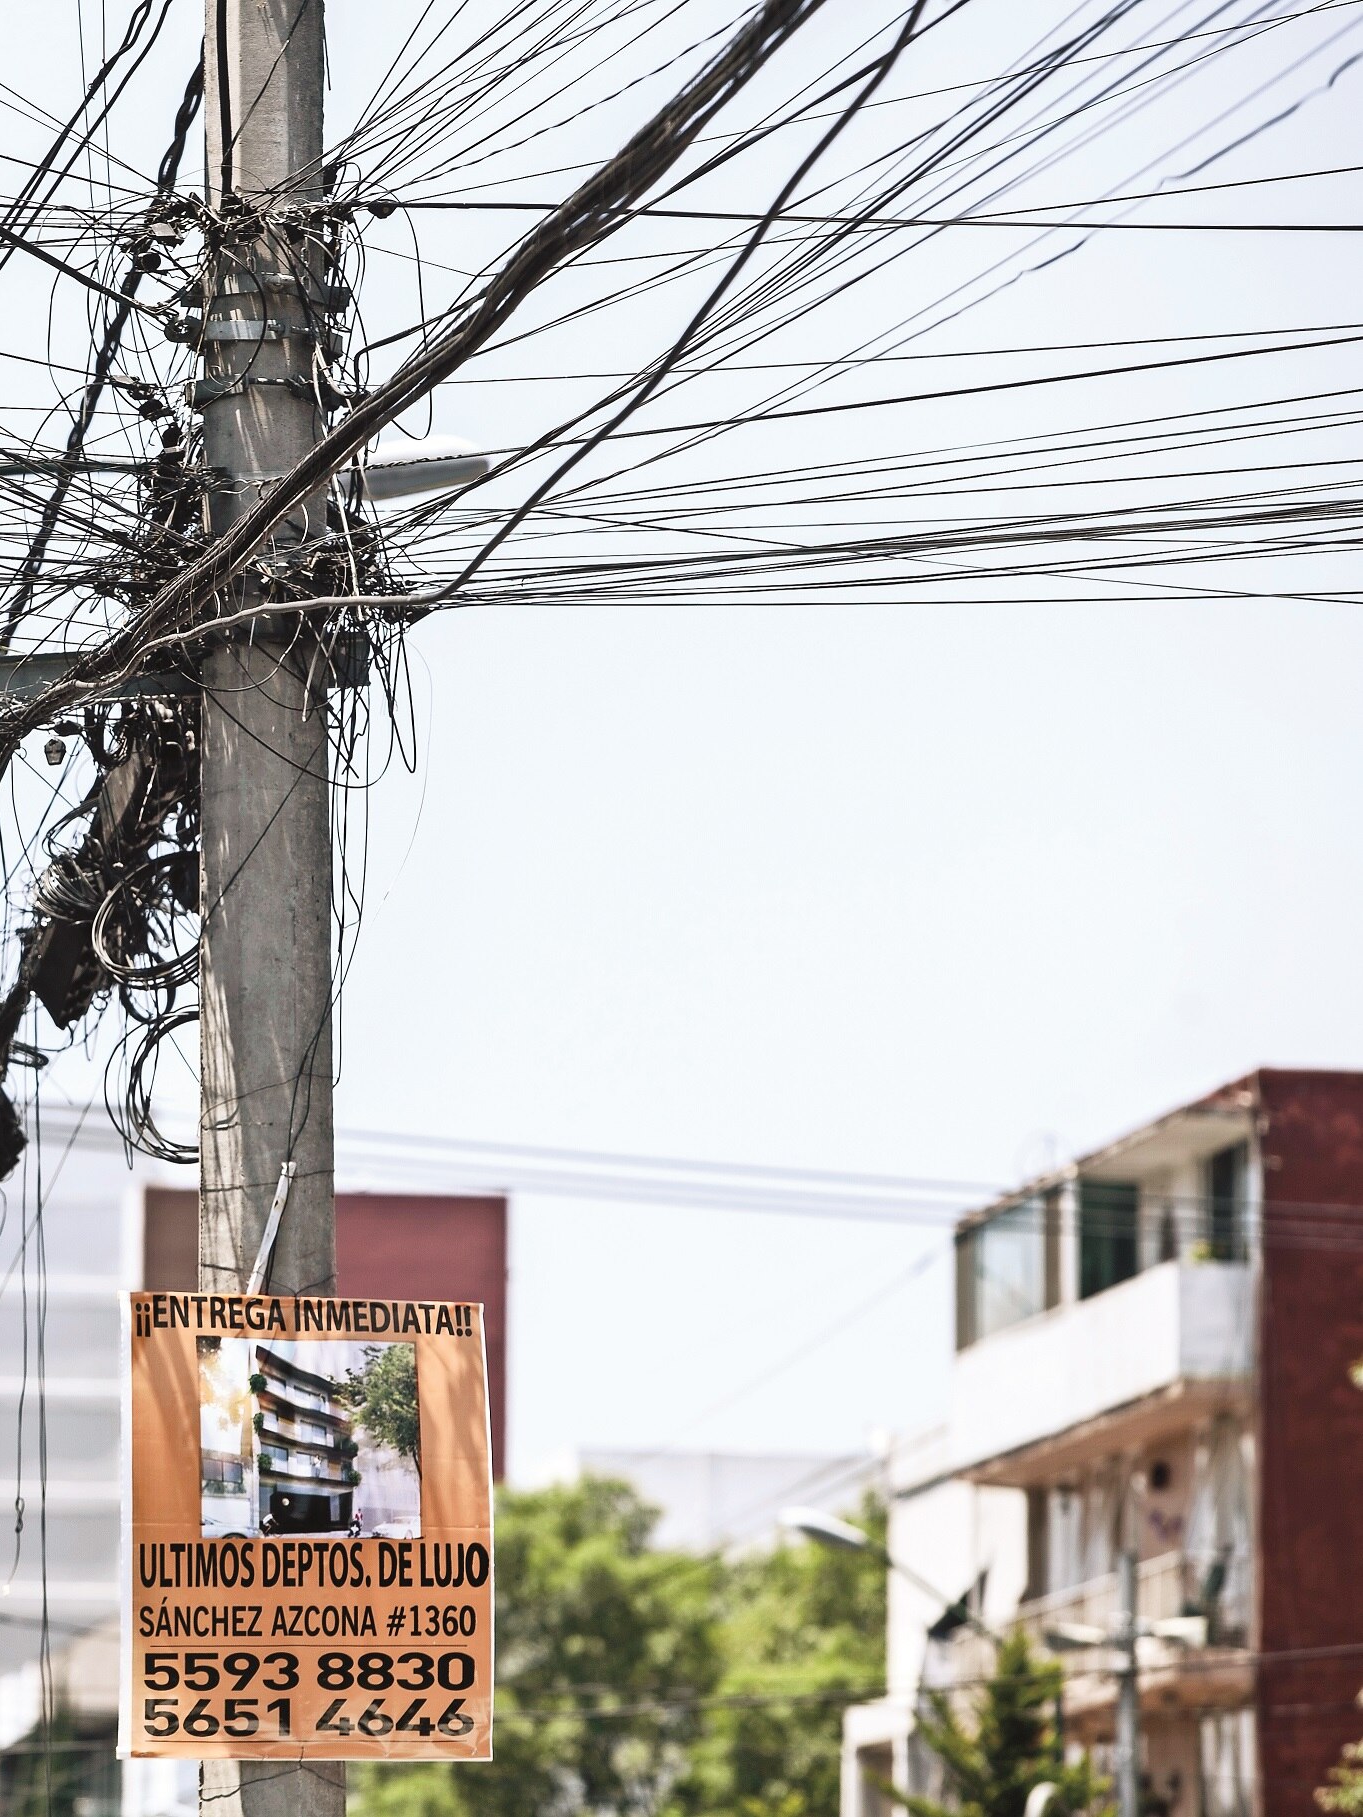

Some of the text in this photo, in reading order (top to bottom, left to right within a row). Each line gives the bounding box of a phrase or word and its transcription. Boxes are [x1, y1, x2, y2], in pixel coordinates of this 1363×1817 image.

[293, 1301, 472, 1337] INMEDIATA!!
[138, 1542, 490, 1589] ULTIMOS DEPTOS. DE LUJO
[138, 1596, 477, 1638] SÁNCHEZ AZCONA #1360
[143, 1651, 476, 1692] 5593 8830
[143, 1698, 476, 1737] 5651 4646
